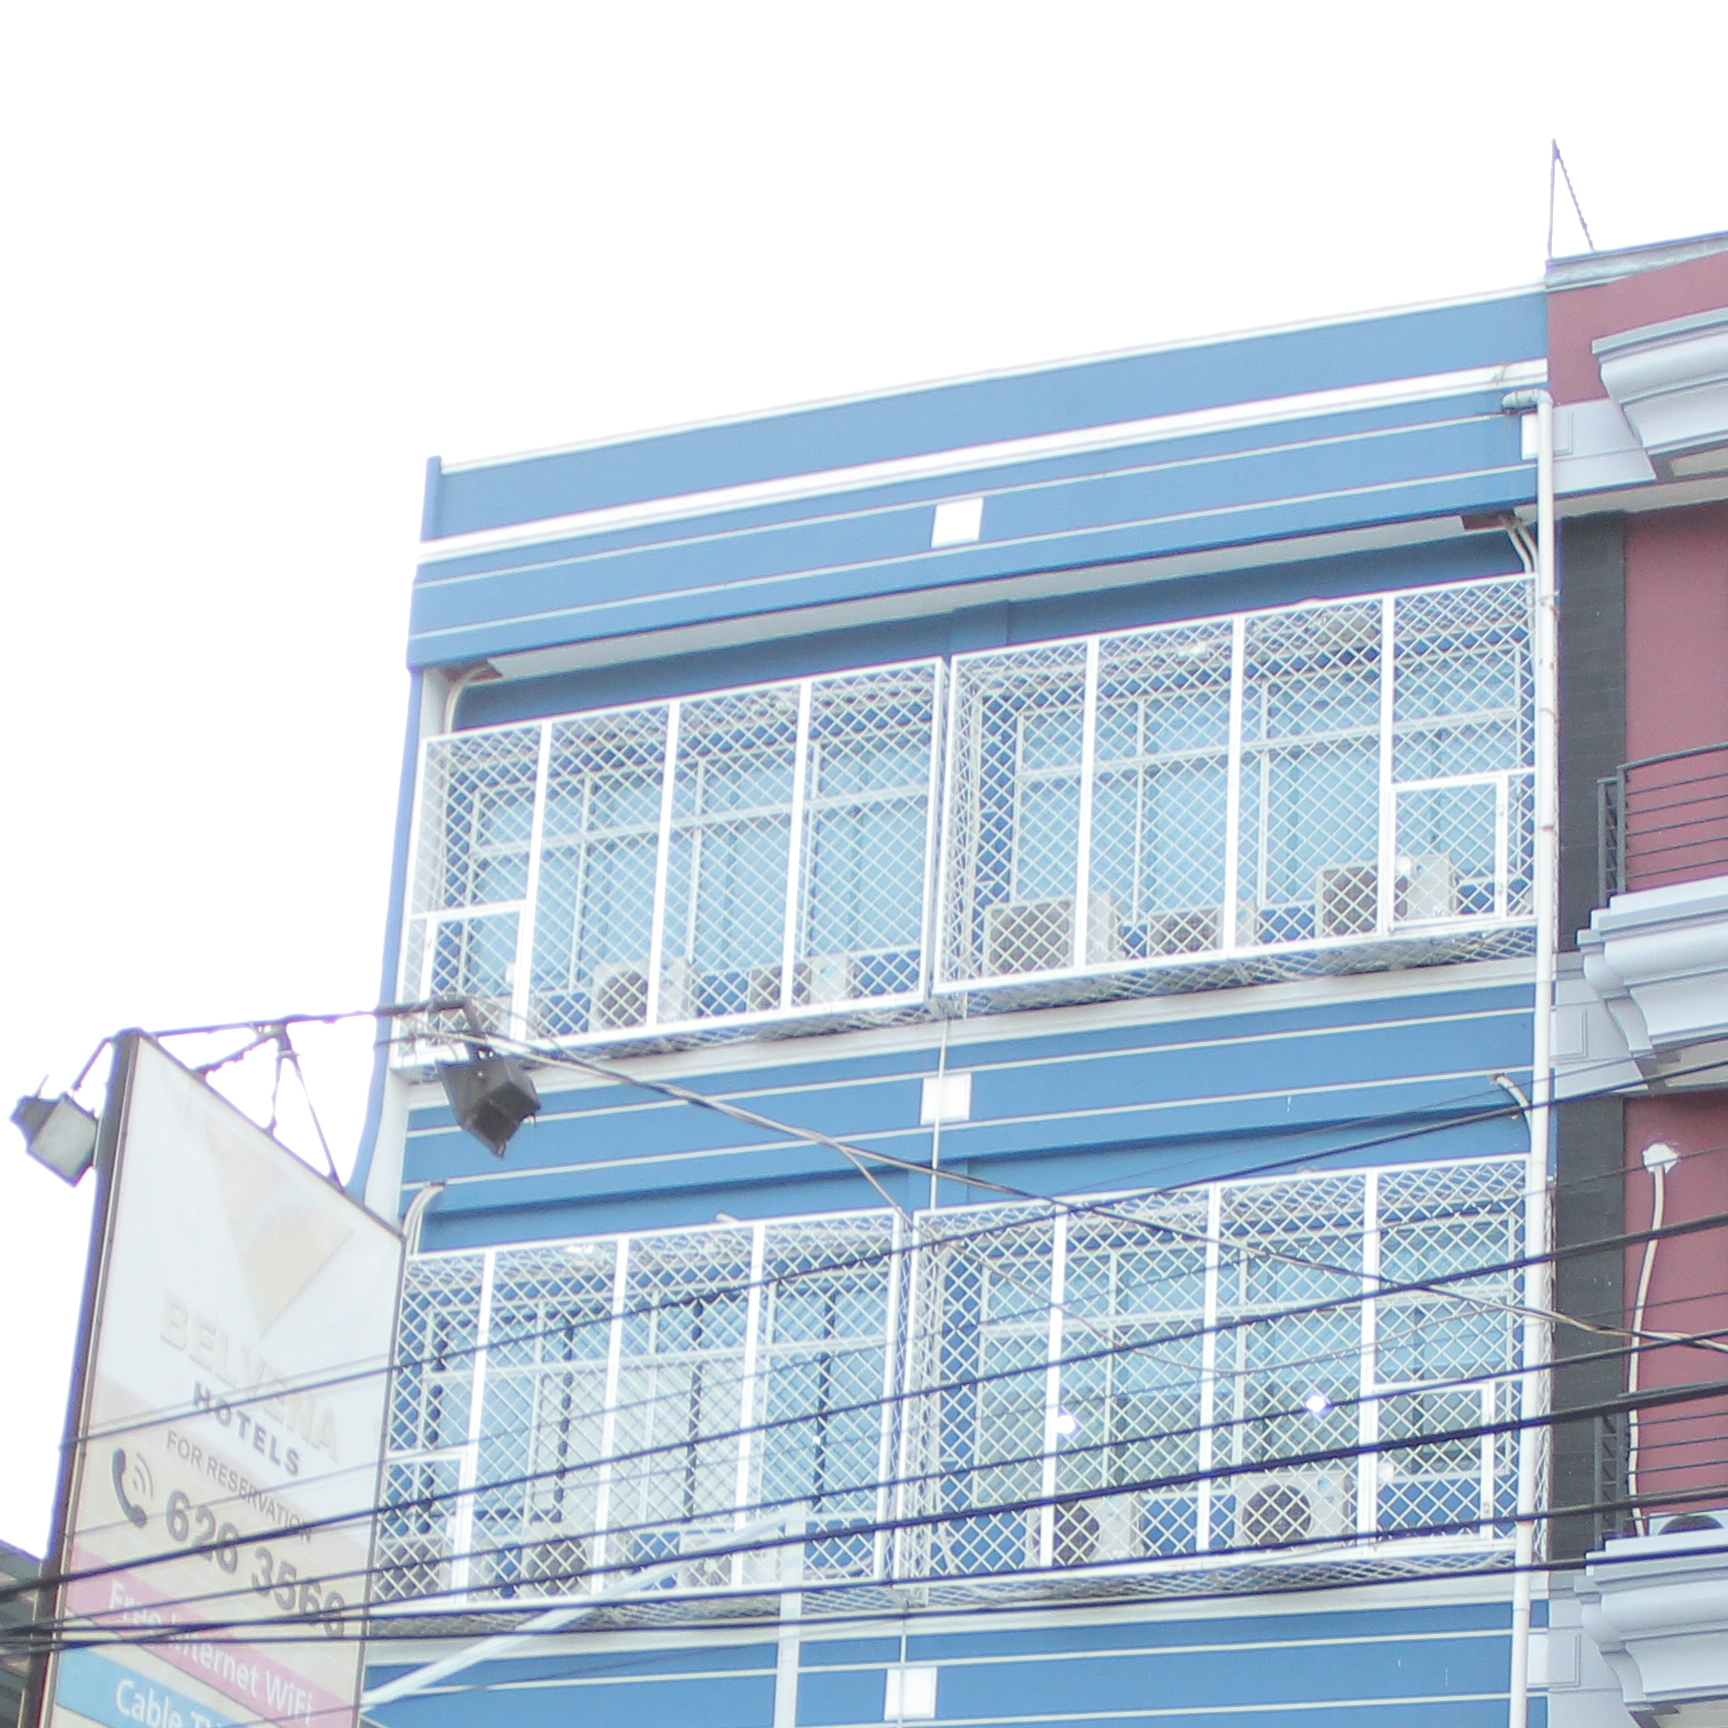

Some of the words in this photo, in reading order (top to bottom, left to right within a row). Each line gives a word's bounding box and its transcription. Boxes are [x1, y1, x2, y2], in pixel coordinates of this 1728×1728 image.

[192, 1380, 300, 1477] HOTELS
[167, 1429, 202, 1470] FOR
[207, 1455, 313, 1545] RESERVATION
[265, 1669, 313, 1727] WiFi
